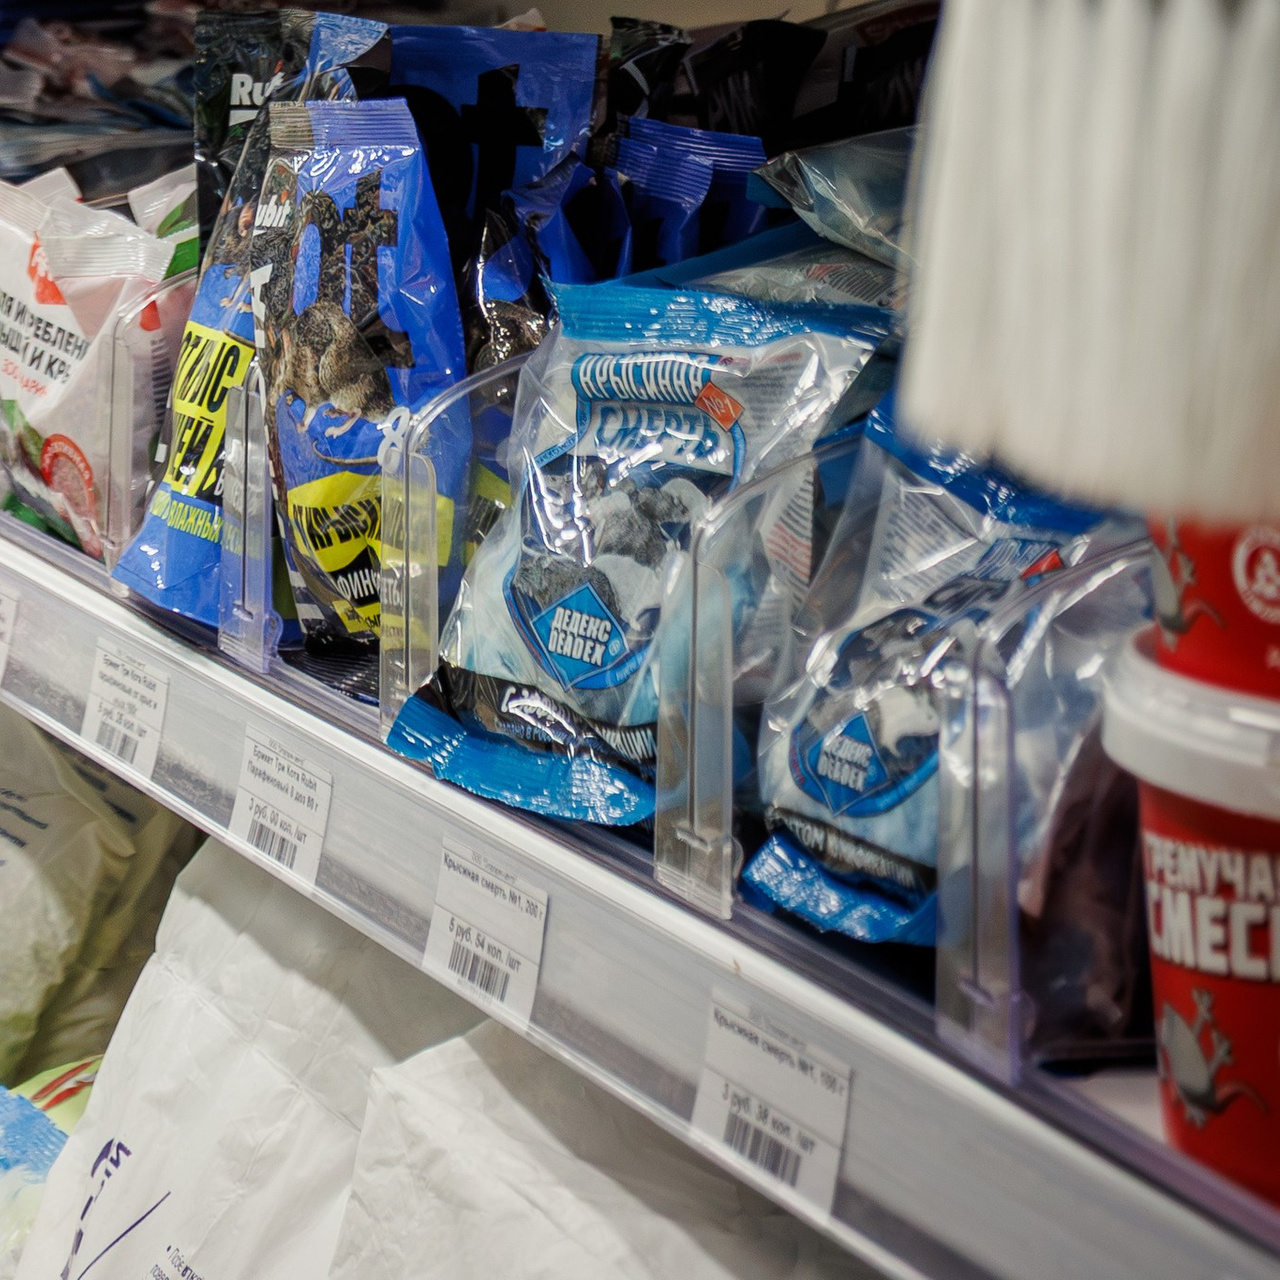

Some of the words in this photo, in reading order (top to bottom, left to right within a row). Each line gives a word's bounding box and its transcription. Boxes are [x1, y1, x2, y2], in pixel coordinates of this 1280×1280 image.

[703, 395, 736, 422] №1
[552, 604, 614, 643] ДЕДЕКС
[246, 759, 290, 795] Парафиновый
[252, 744, 275, 766] Брикет
[275, 756, 286, 772] Три
[287, 764, 300, 782] Кота
[300, 772, 317, 793] Rubit
[254, 803, 269, 822] руб.
[269, 810, 280, 828] 00
[279, 819, 293, 837] коп.
[293, 824, 308, 846] /шт
[443, 851, 480, 884] Крысиная
[480, 877, 507, 901] смерть
[525, 899, 539, 919] 200
[448, 916, 455, 933] 5
[455, 924, 472, 945] руб.
[474, 932, 486, 952] 54
[486, 943, 504, 965] коп.
[504, 949, 522, 974] /шт
